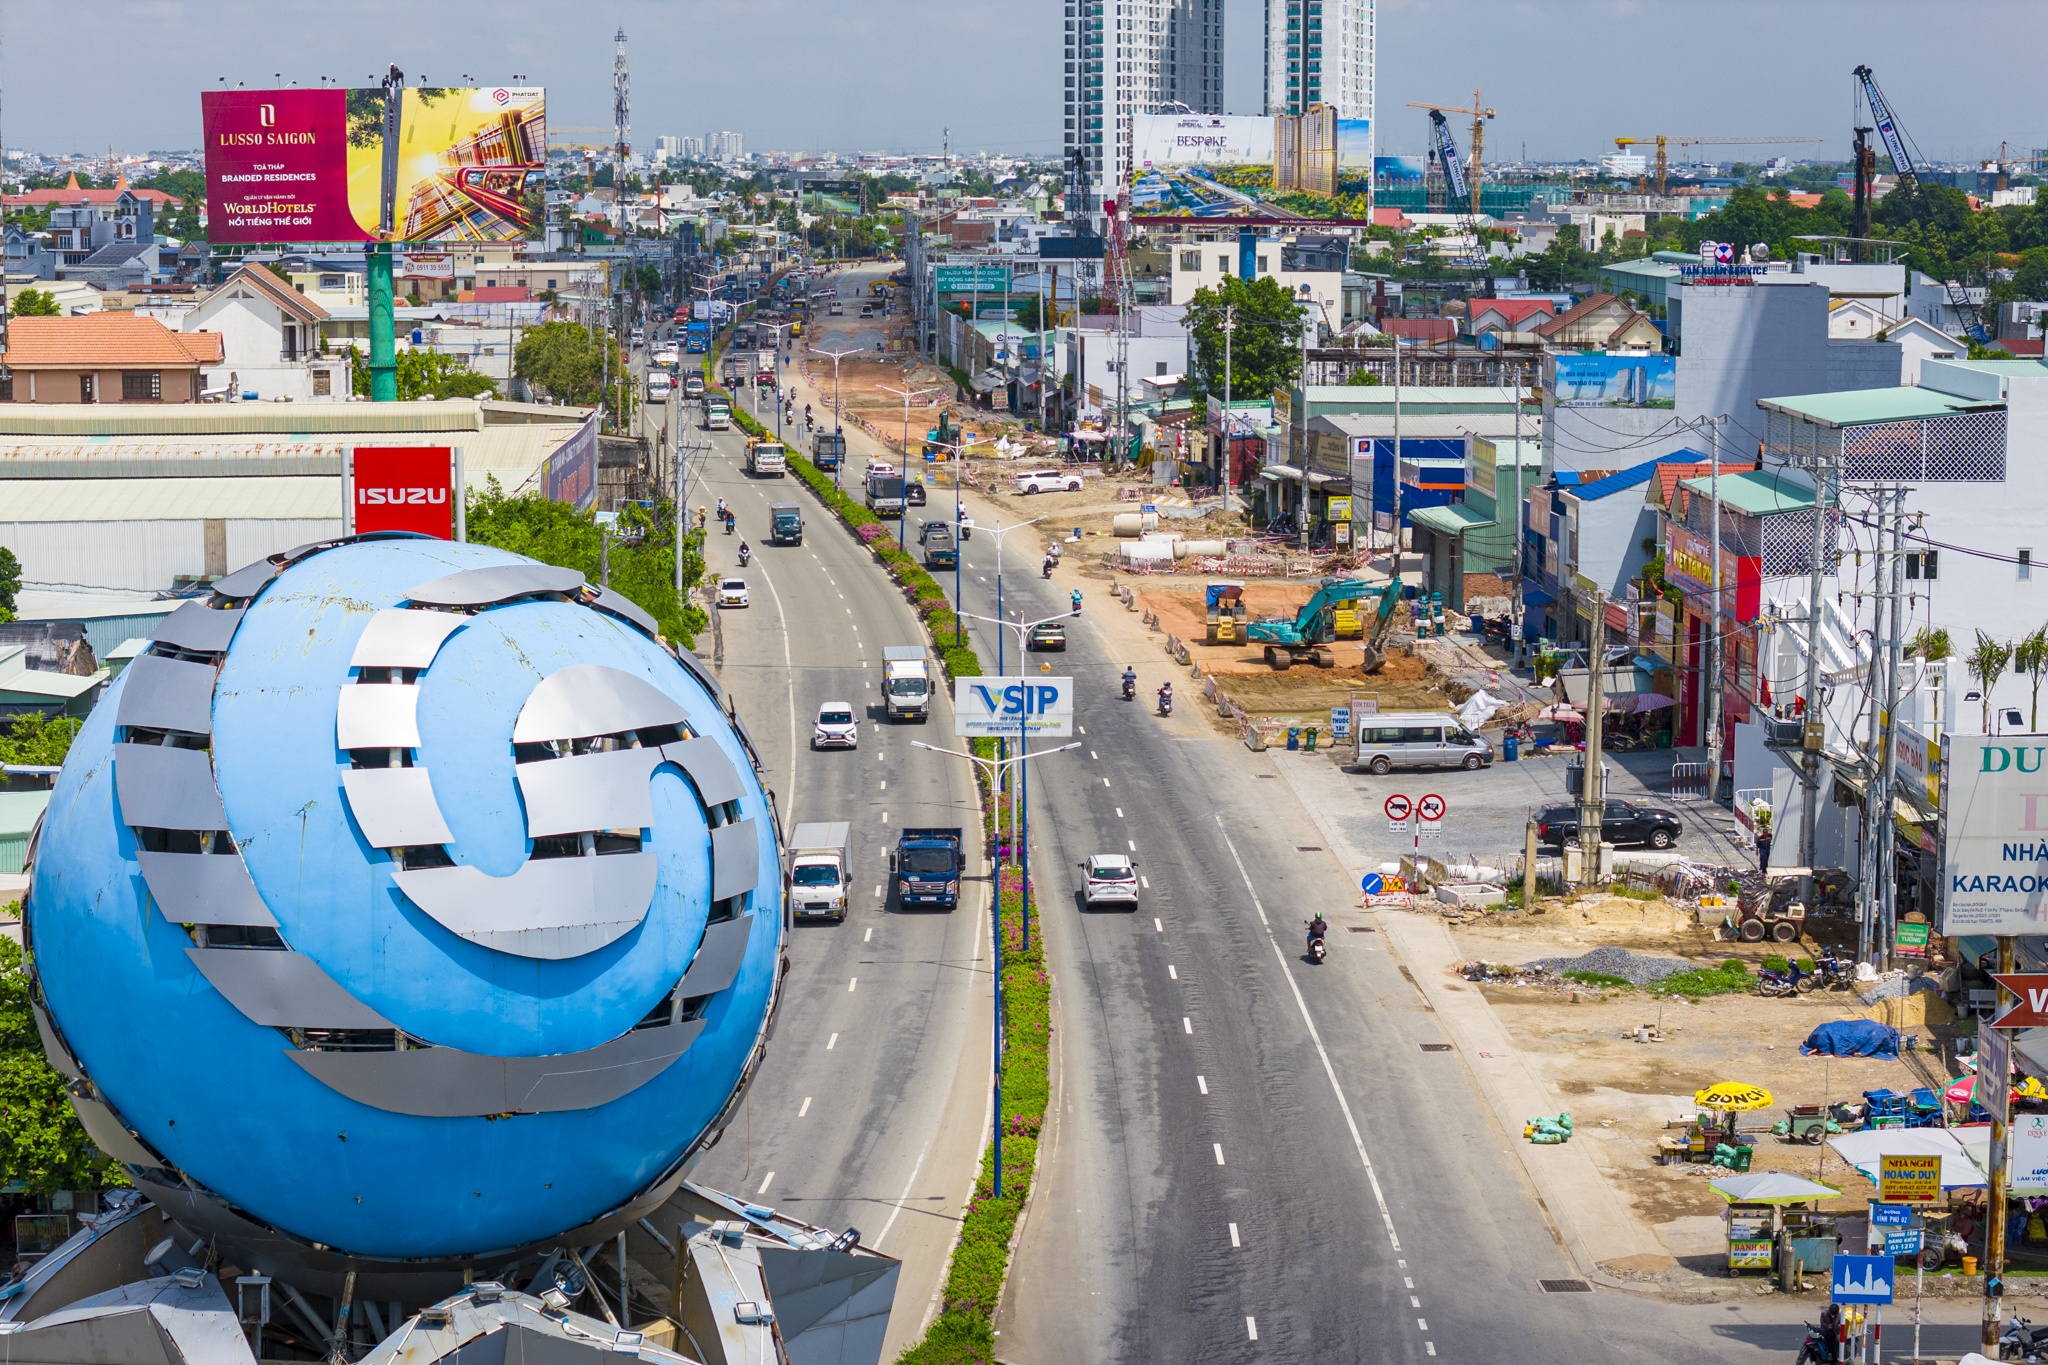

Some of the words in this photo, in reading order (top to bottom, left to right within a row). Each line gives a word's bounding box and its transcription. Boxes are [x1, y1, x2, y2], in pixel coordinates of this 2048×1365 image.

[220, 133, 263, 146] LUSSO
[267, 132, 316, 145] SAIGON
[1177, 136, 1227, 147] BESPOKE
[1889, 134, 1900, 153] TUNG
[1897, 152, 1908, 170] FENG
[267, 162, 285, 170] THÁP
[221, 174, 262, 183] BRANDED
[264, 173, 316, 182] RESIDENCES
[1452, 159, 1460, 178] TUNG
[1457, 177, 1466, 196] FENG
[246, 216, 272, 226] TIẾNG
[273, 215, 291, 225] THẾ
[292, 215, 312, 225] GIỚI
[1729, 266, 1768, 275] SERVICE
[359, 488, 446, 505] ISUZU
[970, 685, 1059, 714] VSIP
[1979, 747, 2046, 773] DU
[1889, 1159, 1909, 1168] NHÀ
[1910, 1157, 1934, 1168] NGHỈ
[1884, 1167, 1916, 1180] HOÀNG
[1918, 1170, 1938, 1180] DUY
